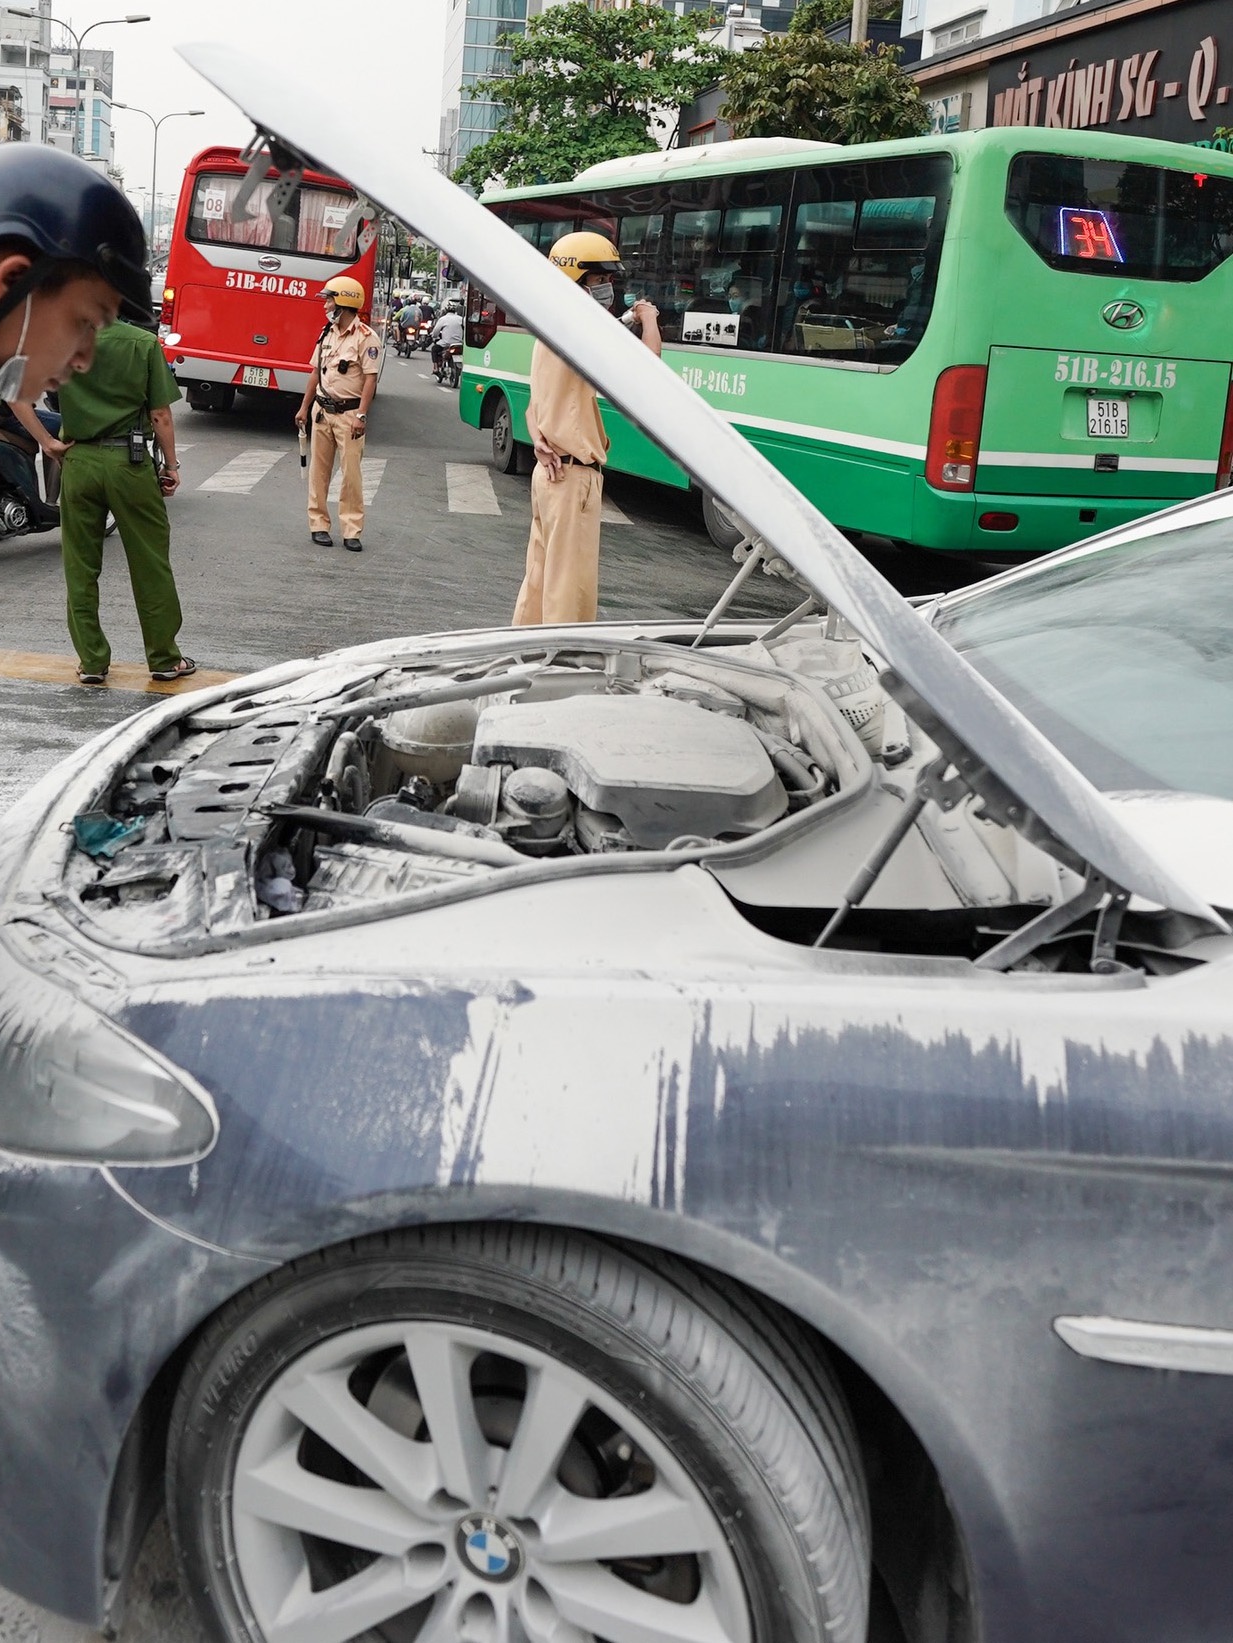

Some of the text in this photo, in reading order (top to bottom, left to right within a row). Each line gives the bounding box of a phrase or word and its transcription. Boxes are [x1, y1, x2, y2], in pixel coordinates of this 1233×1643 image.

[1045, 58, 1117, 128] KÍNH
[1117, 49, 1162, 121] SG
[206, 198, 223, 212] 08
[1071, 217, 1114, 257] 34
[225, 271, 307, 297] 51B-401.63
[250, 367, 264, 377] 51B
[1054, 354, 1177, 388] 51B-216.15
[1097, 402, 1119, 418] 51B
[1090, 418, 1127, 435] 216.15
